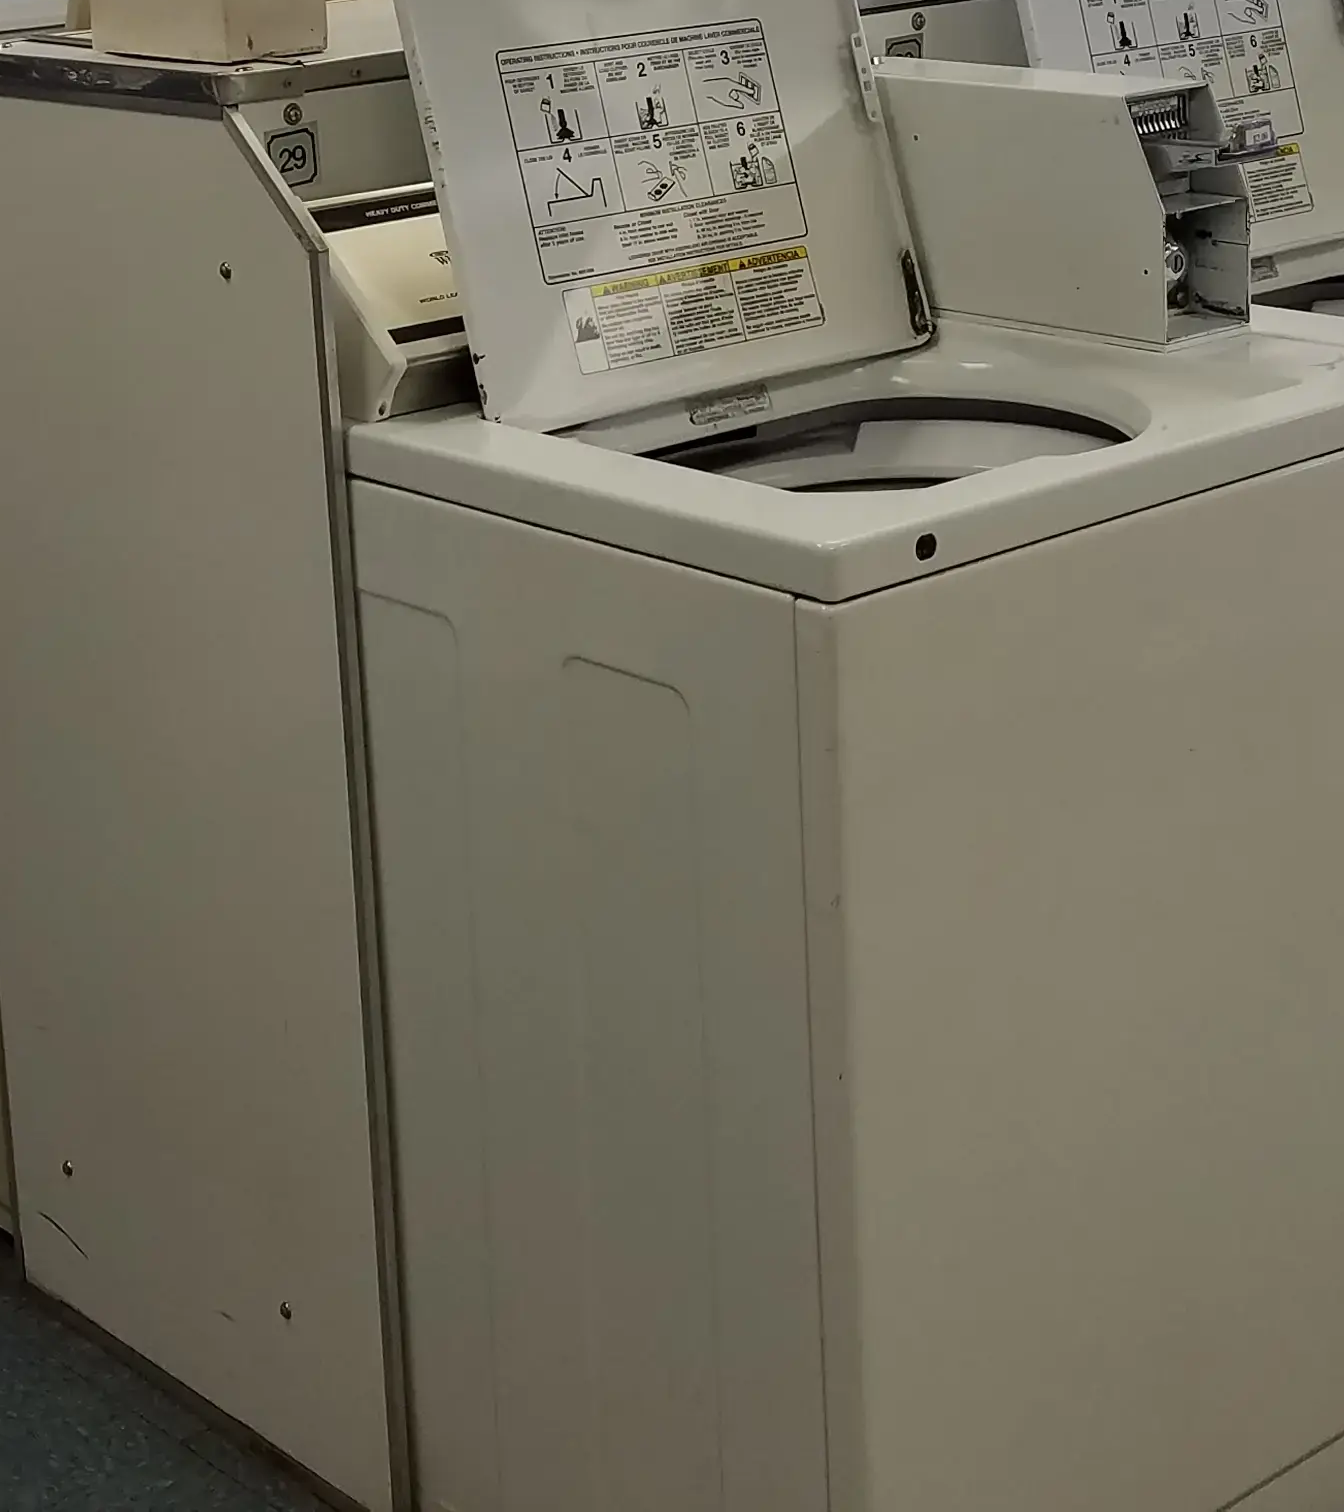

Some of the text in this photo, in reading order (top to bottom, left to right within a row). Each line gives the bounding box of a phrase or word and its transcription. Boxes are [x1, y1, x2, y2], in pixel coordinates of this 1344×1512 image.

[1250, 35, 1257, 47] 6
[720, 50, 730, 65] 3
[1188, 44, 1196, 57] 5
[1123, 54, 1131, 66] 4
[636, 63, 648, 78] 2
[546, 73, 554, 89] 1
[736, 121, 746, 136] 6
[652, 134, 662, 149] 5
[279, 145, 308, 174] 29
[562, 148, 572, 163] 4
[390, 204, 410, 214] DUTY
[747, 251, 800, 269] ADVERTENCIA
